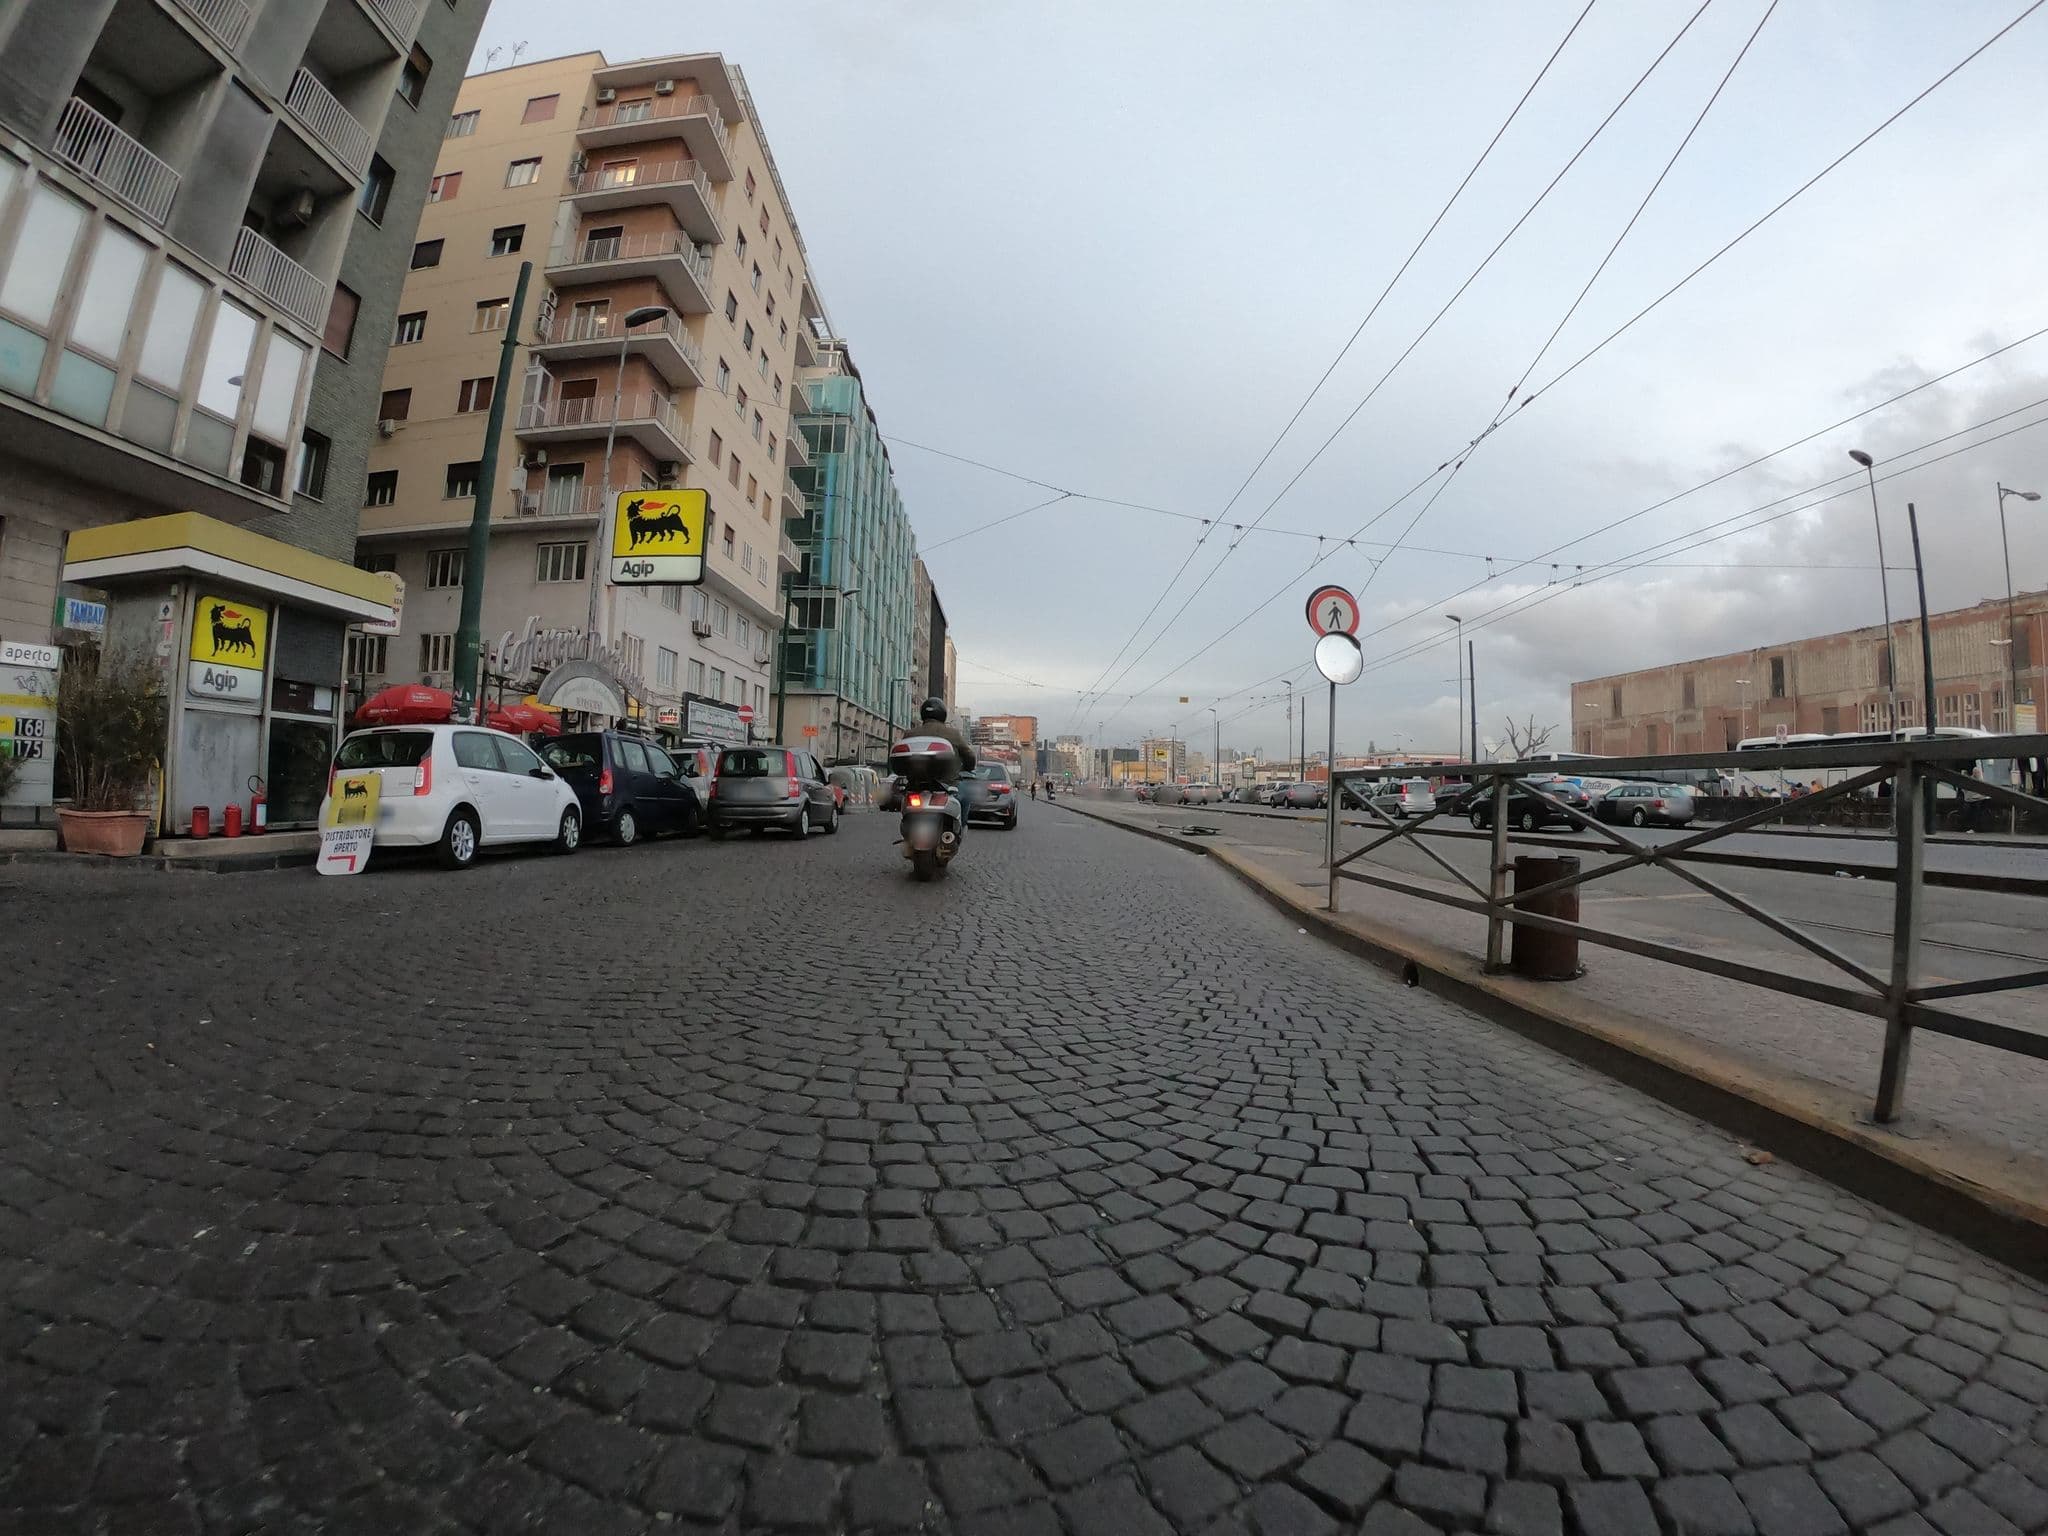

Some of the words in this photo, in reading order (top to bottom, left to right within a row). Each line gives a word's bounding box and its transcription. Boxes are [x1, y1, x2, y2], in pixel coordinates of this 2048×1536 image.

[620, 560, 654, 578] Agip
[5, 647, 52, 663] aperto
[203, 667, 238, 692] Agip
[16, 719, 44, 737] 168
[15, 739, 42, 758] 175
[325, 828, 371, 842] DISTRIBUTORE
[333, 843, 358, 854] APERTO
